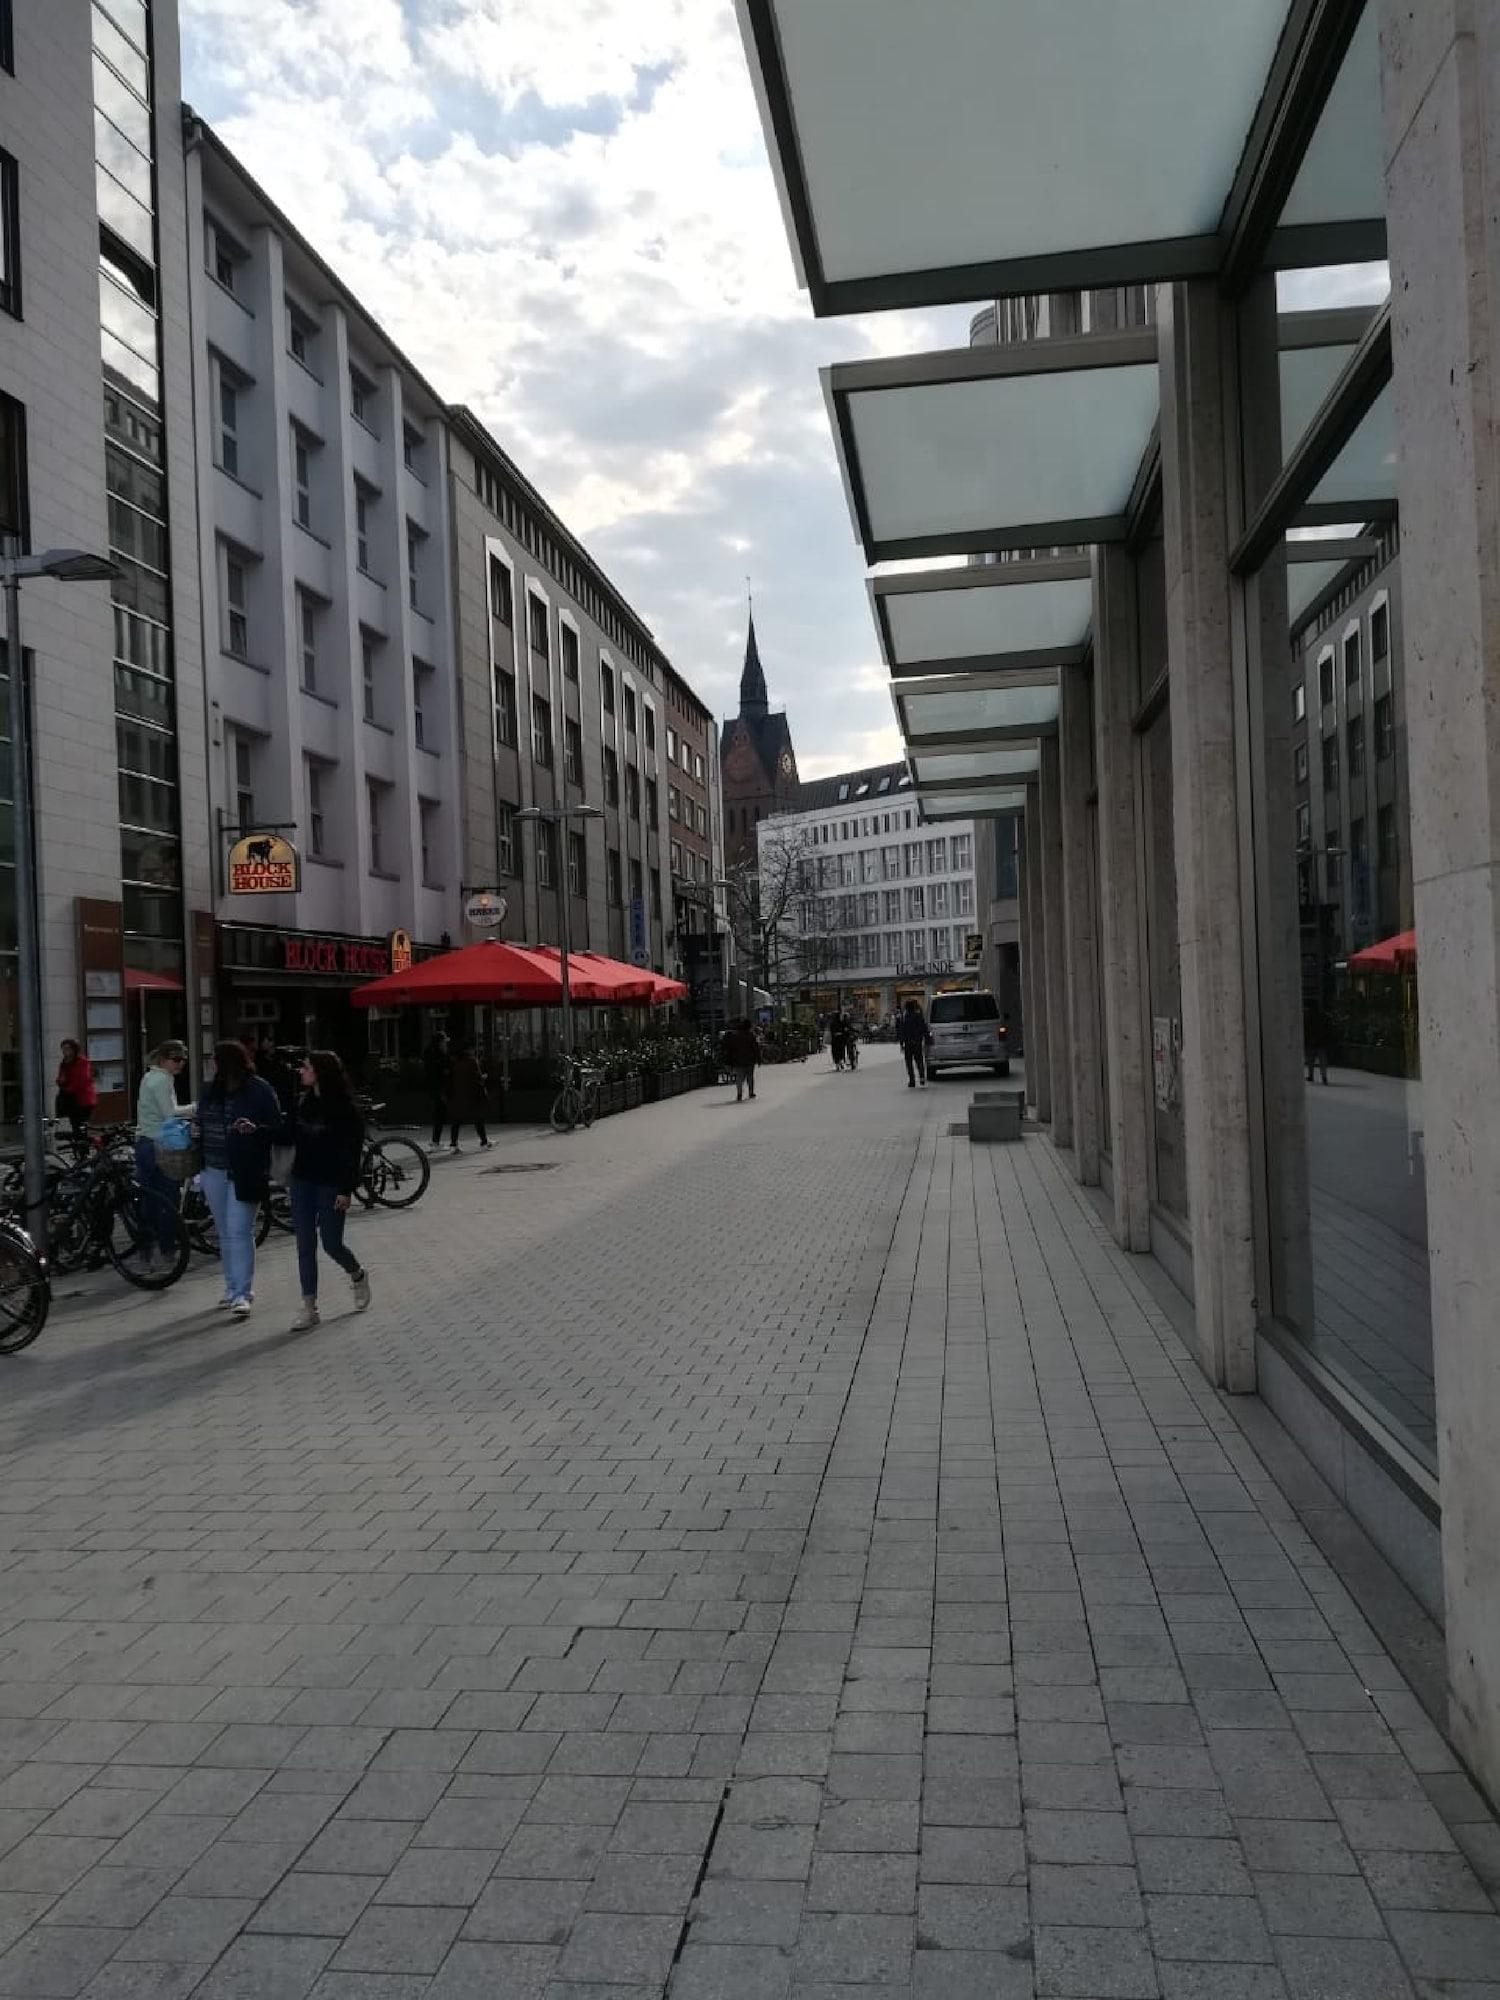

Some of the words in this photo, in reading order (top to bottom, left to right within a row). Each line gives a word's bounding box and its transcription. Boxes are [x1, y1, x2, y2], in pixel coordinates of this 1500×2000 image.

[232, 863, 291, 874] BLOCK
[232, 874, 291, 889] HOUSE
[285, 940, 337, 970] BLOCK
[344, 944, 387, 974] HOUSE
